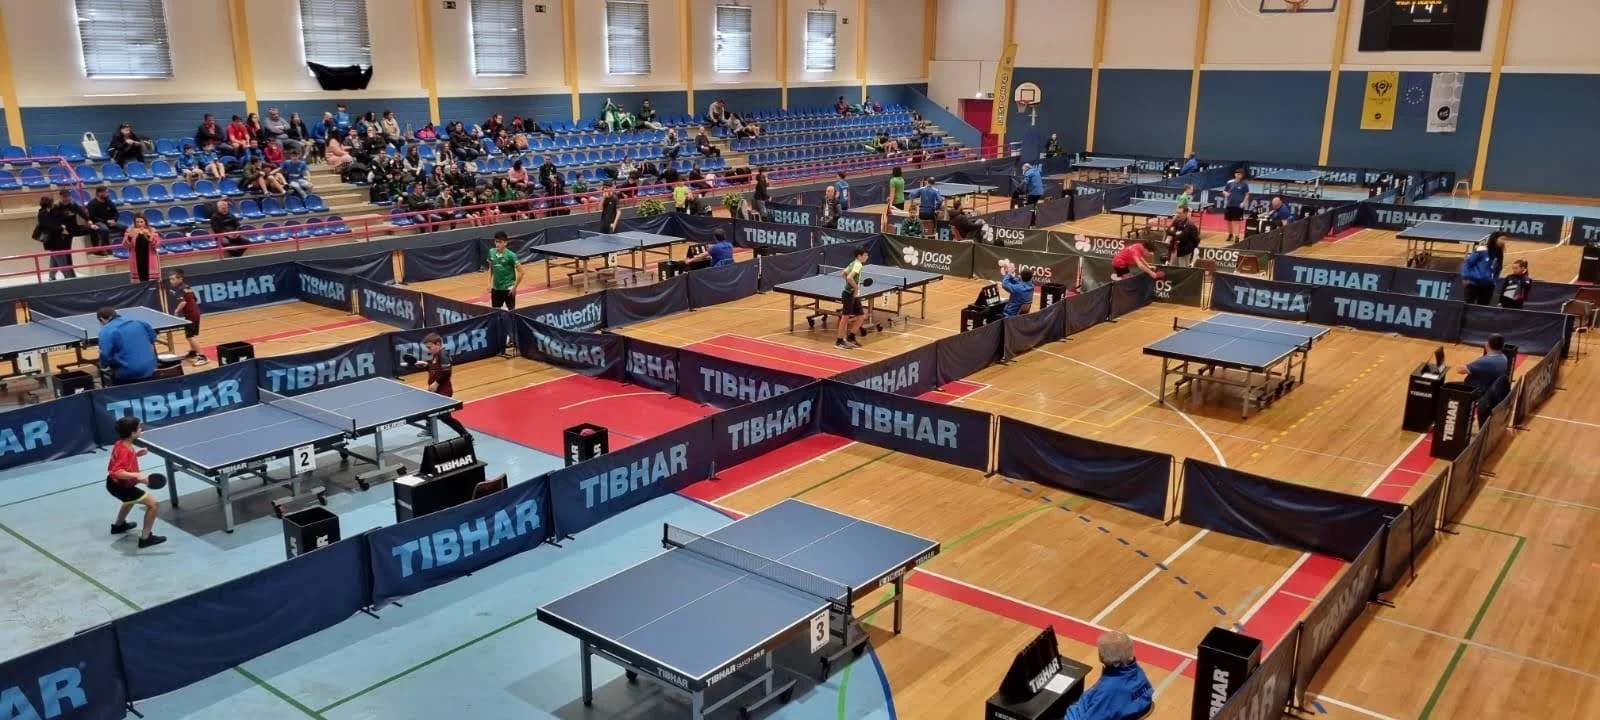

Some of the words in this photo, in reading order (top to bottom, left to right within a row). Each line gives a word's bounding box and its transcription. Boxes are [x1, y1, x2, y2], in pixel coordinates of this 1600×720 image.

[743, 227, 797, 247] TIBHAR
[837, 217, 874, 233] BHAR
[996, 228, 1025, 240] JOGOS
[920, 250, 953, 265] JOGOS
[1093, 238, 1126, 251] JOGOS
[1203, 249, 1240, 262] JOGOS
[191, 273, 277, 305] TIBHAR
[299, 273, 346, 302] TIBHAR
[1292, 265, 1380, 292] TIBHAR
[364, 288, 415, 320] TIBHAR
[547, 302, 602, 329] Butterfly
[1334, 296, 1434, 329] TIBHAR
[25, 355, 32, 368] 1
[533, 331, 606, 368] TIBHAR
[266, 352, 376, 393] TIBHAR
[106, 379, 243, 424] TIBHAR
[727, 399, 813, 451] TIBHAR
[847, 400, 959, 449] TIBHAR
[1442, 400, 1460, 441] TIBHAR
[300, 451, 309, 467] 2
[434, 454, 473, 474] TIBHAR
[580, 443, 690, 509] TIBHAR
[392, 499, 541, 578] TIBHAR
[816, 621, 825, 641] 3
[656, 666, 689, 688] TIBHAR
[705, 664, 737, 688] TIBHAR
[1029, 657, 1060, 694] TIBHAR
[1208, 668, 1230, 720] BHAR
